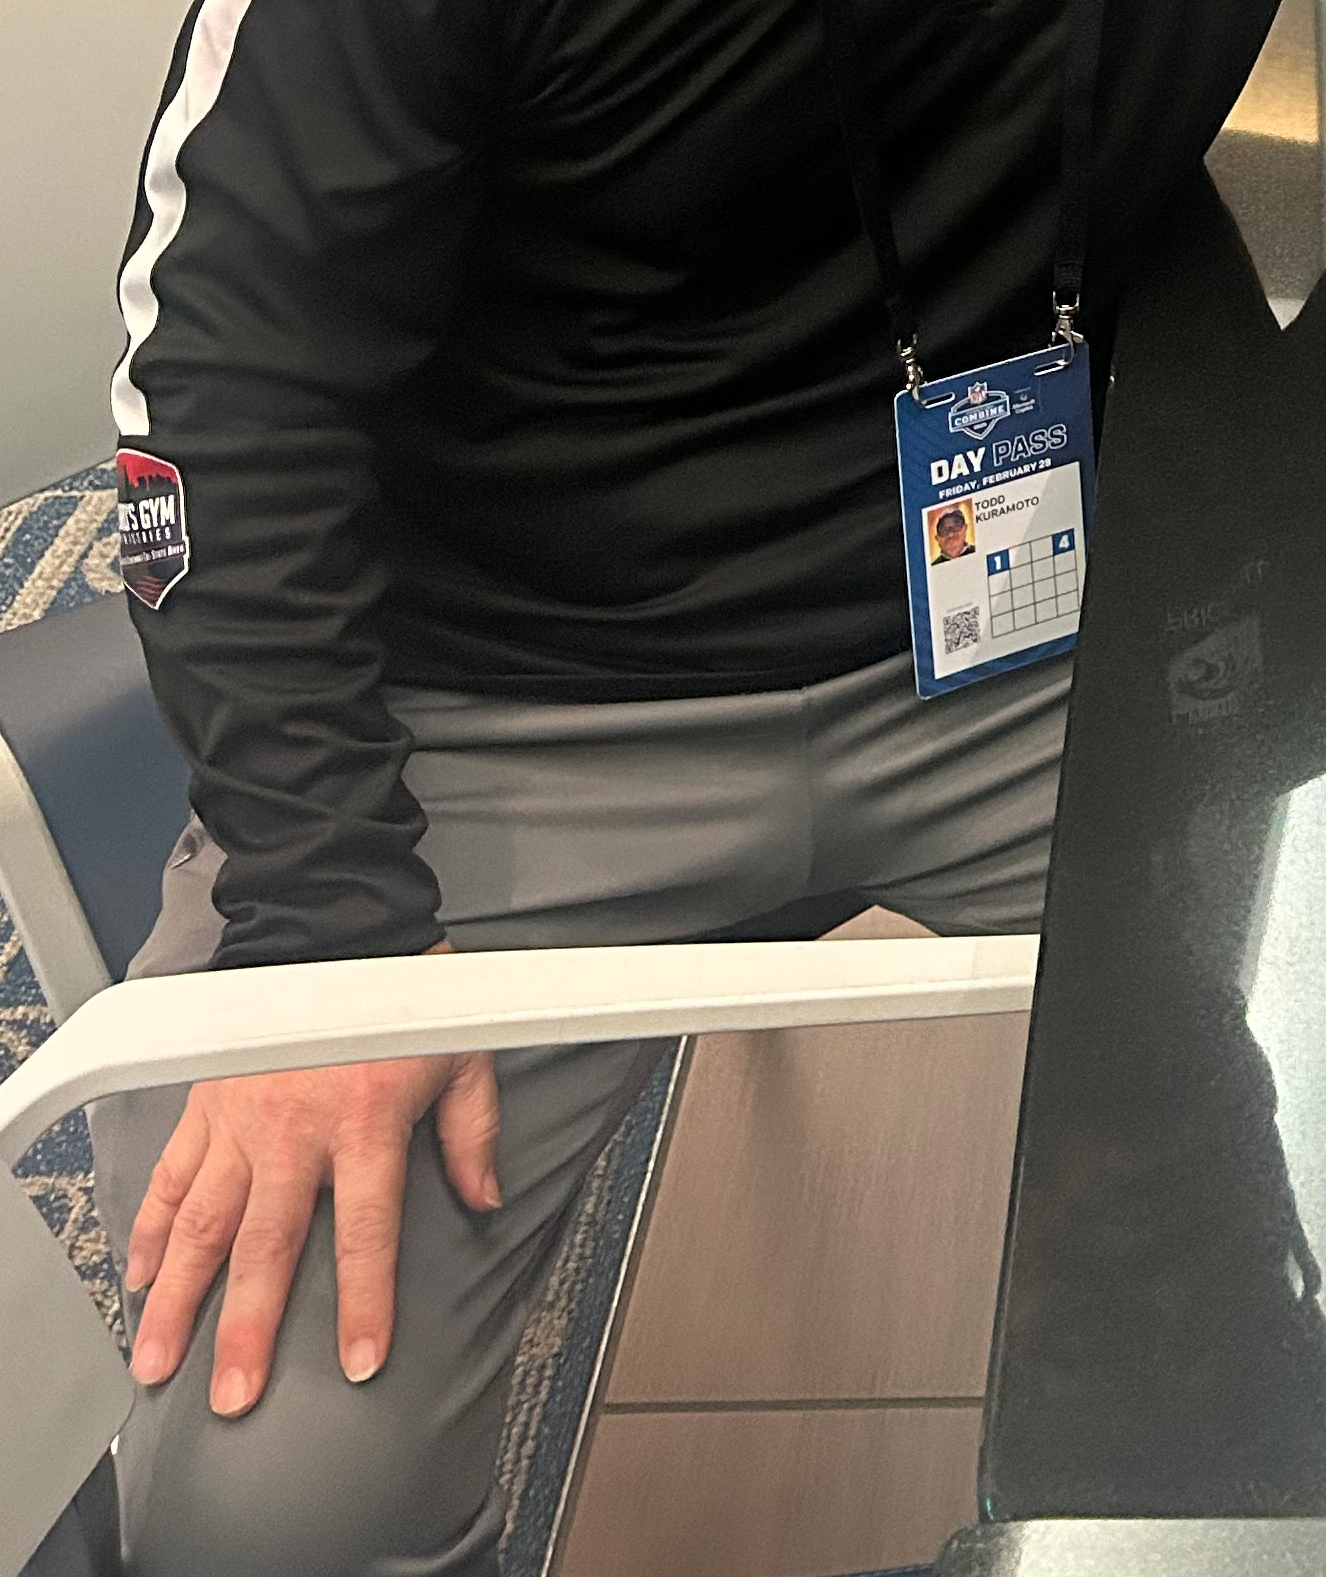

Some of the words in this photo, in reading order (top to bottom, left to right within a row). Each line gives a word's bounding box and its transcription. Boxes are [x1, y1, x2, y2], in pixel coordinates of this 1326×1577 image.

[954, 404, 1006, 426] COMBINE
[931, 447, 985, 485] DAY
[992, 424, 1068, 467] PASS
[983, 461, 1037, 486] FEBRUARY
[138, 494, 176, 530] GYM
[974, 494, 1006, 512] TODD
[975, 496, 1040, 524] KURAMOTO
[1058, 534, 1071, 550] 4
[994, 555, 1003, 571] 1
